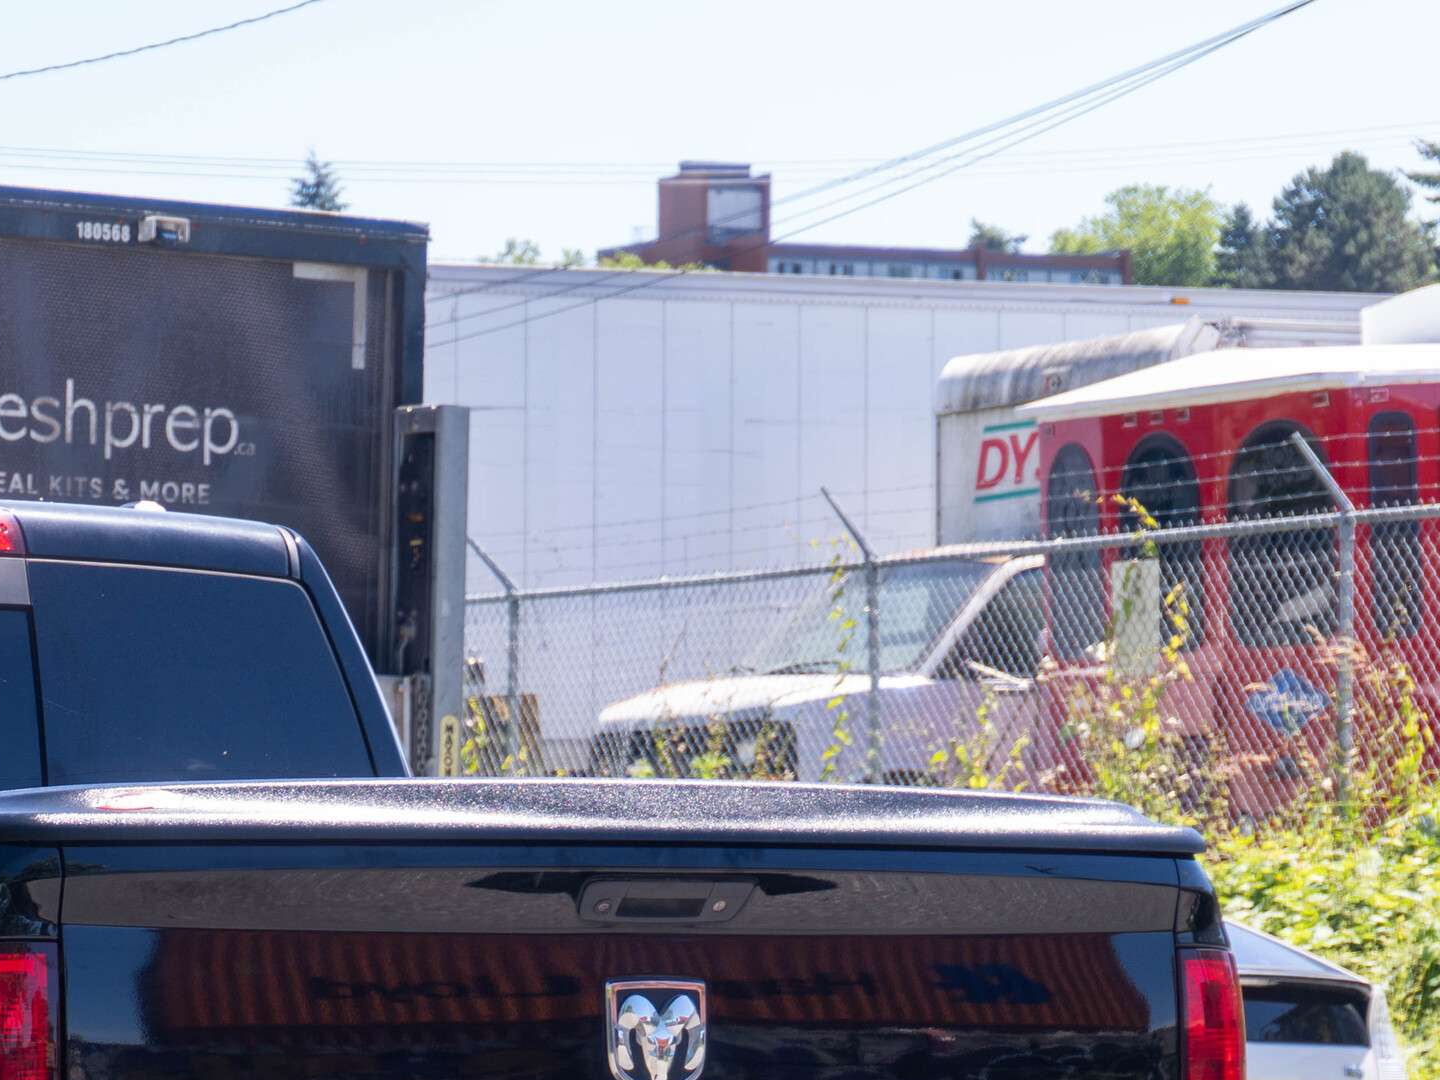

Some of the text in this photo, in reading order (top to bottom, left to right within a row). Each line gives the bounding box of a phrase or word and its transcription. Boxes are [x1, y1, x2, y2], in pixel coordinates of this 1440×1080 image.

[76, 221, 131, 242] 180568
[49, 474, 103, 500] KITS
[114, 478, 129, 500] &
[139, 480, 211, 506] MORE
